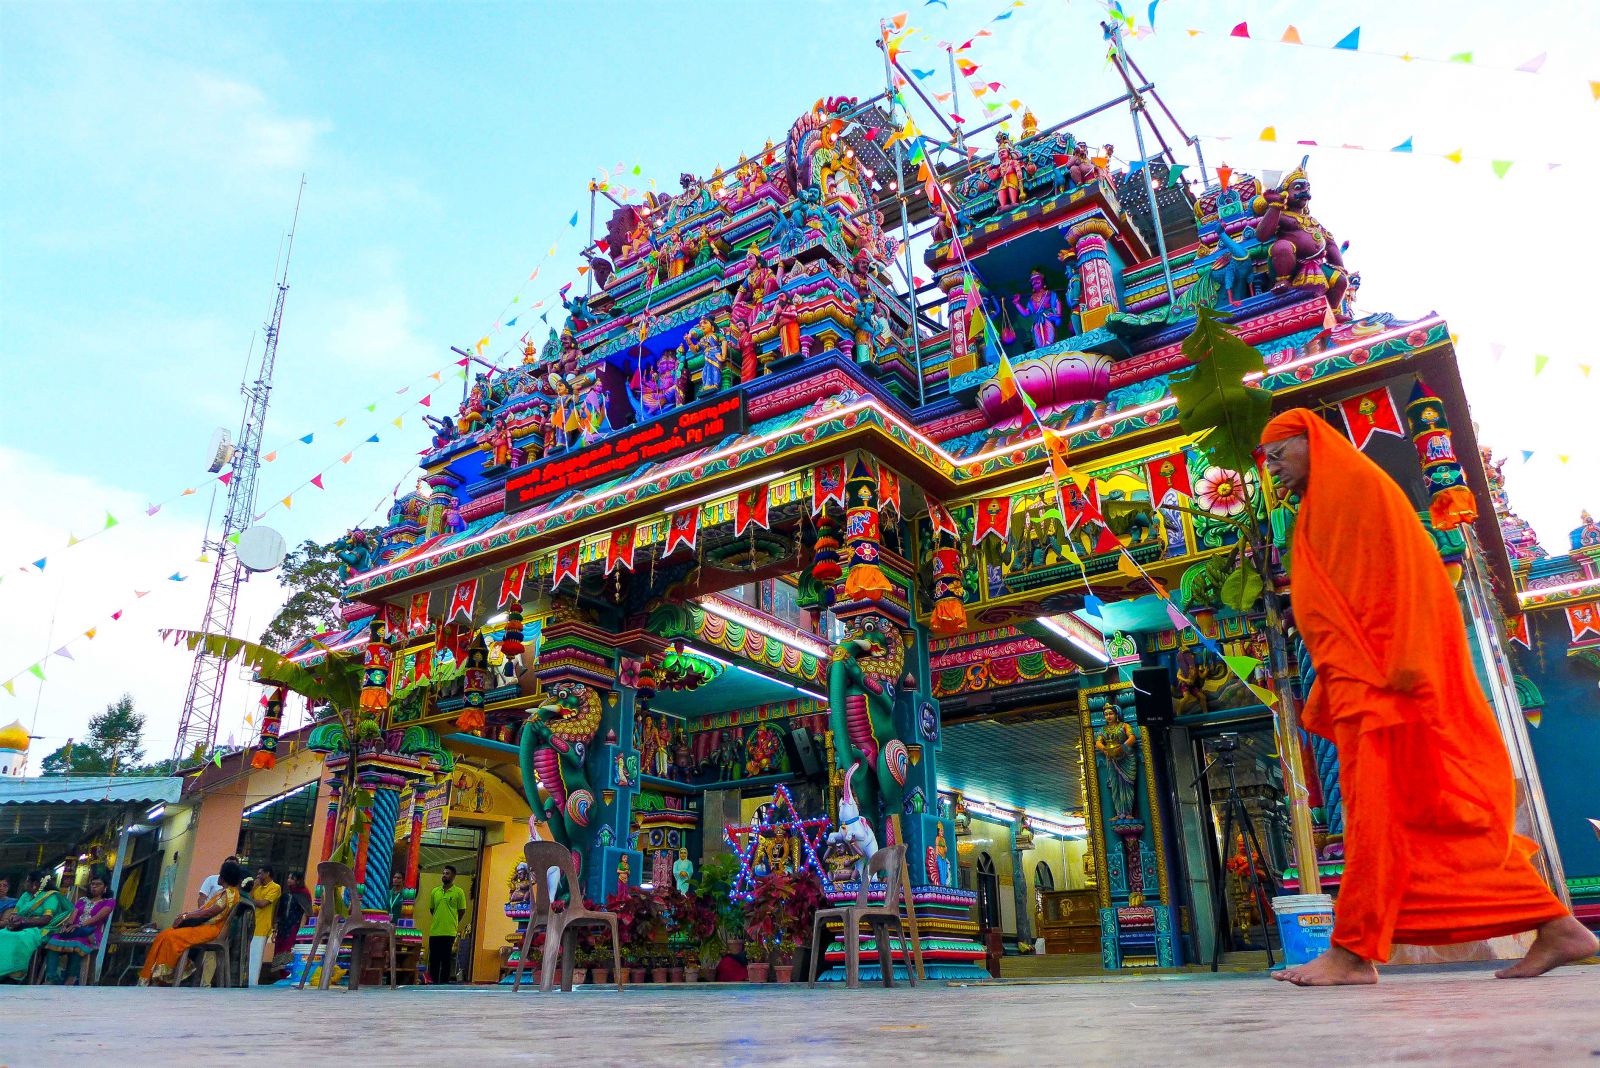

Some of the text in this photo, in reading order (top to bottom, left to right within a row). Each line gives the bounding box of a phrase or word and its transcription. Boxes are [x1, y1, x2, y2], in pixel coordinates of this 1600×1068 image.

[520, 487, 534, 502] Sri
[687, 428, 703, 443] Pg
[704, 418, 724, 436] Hill
